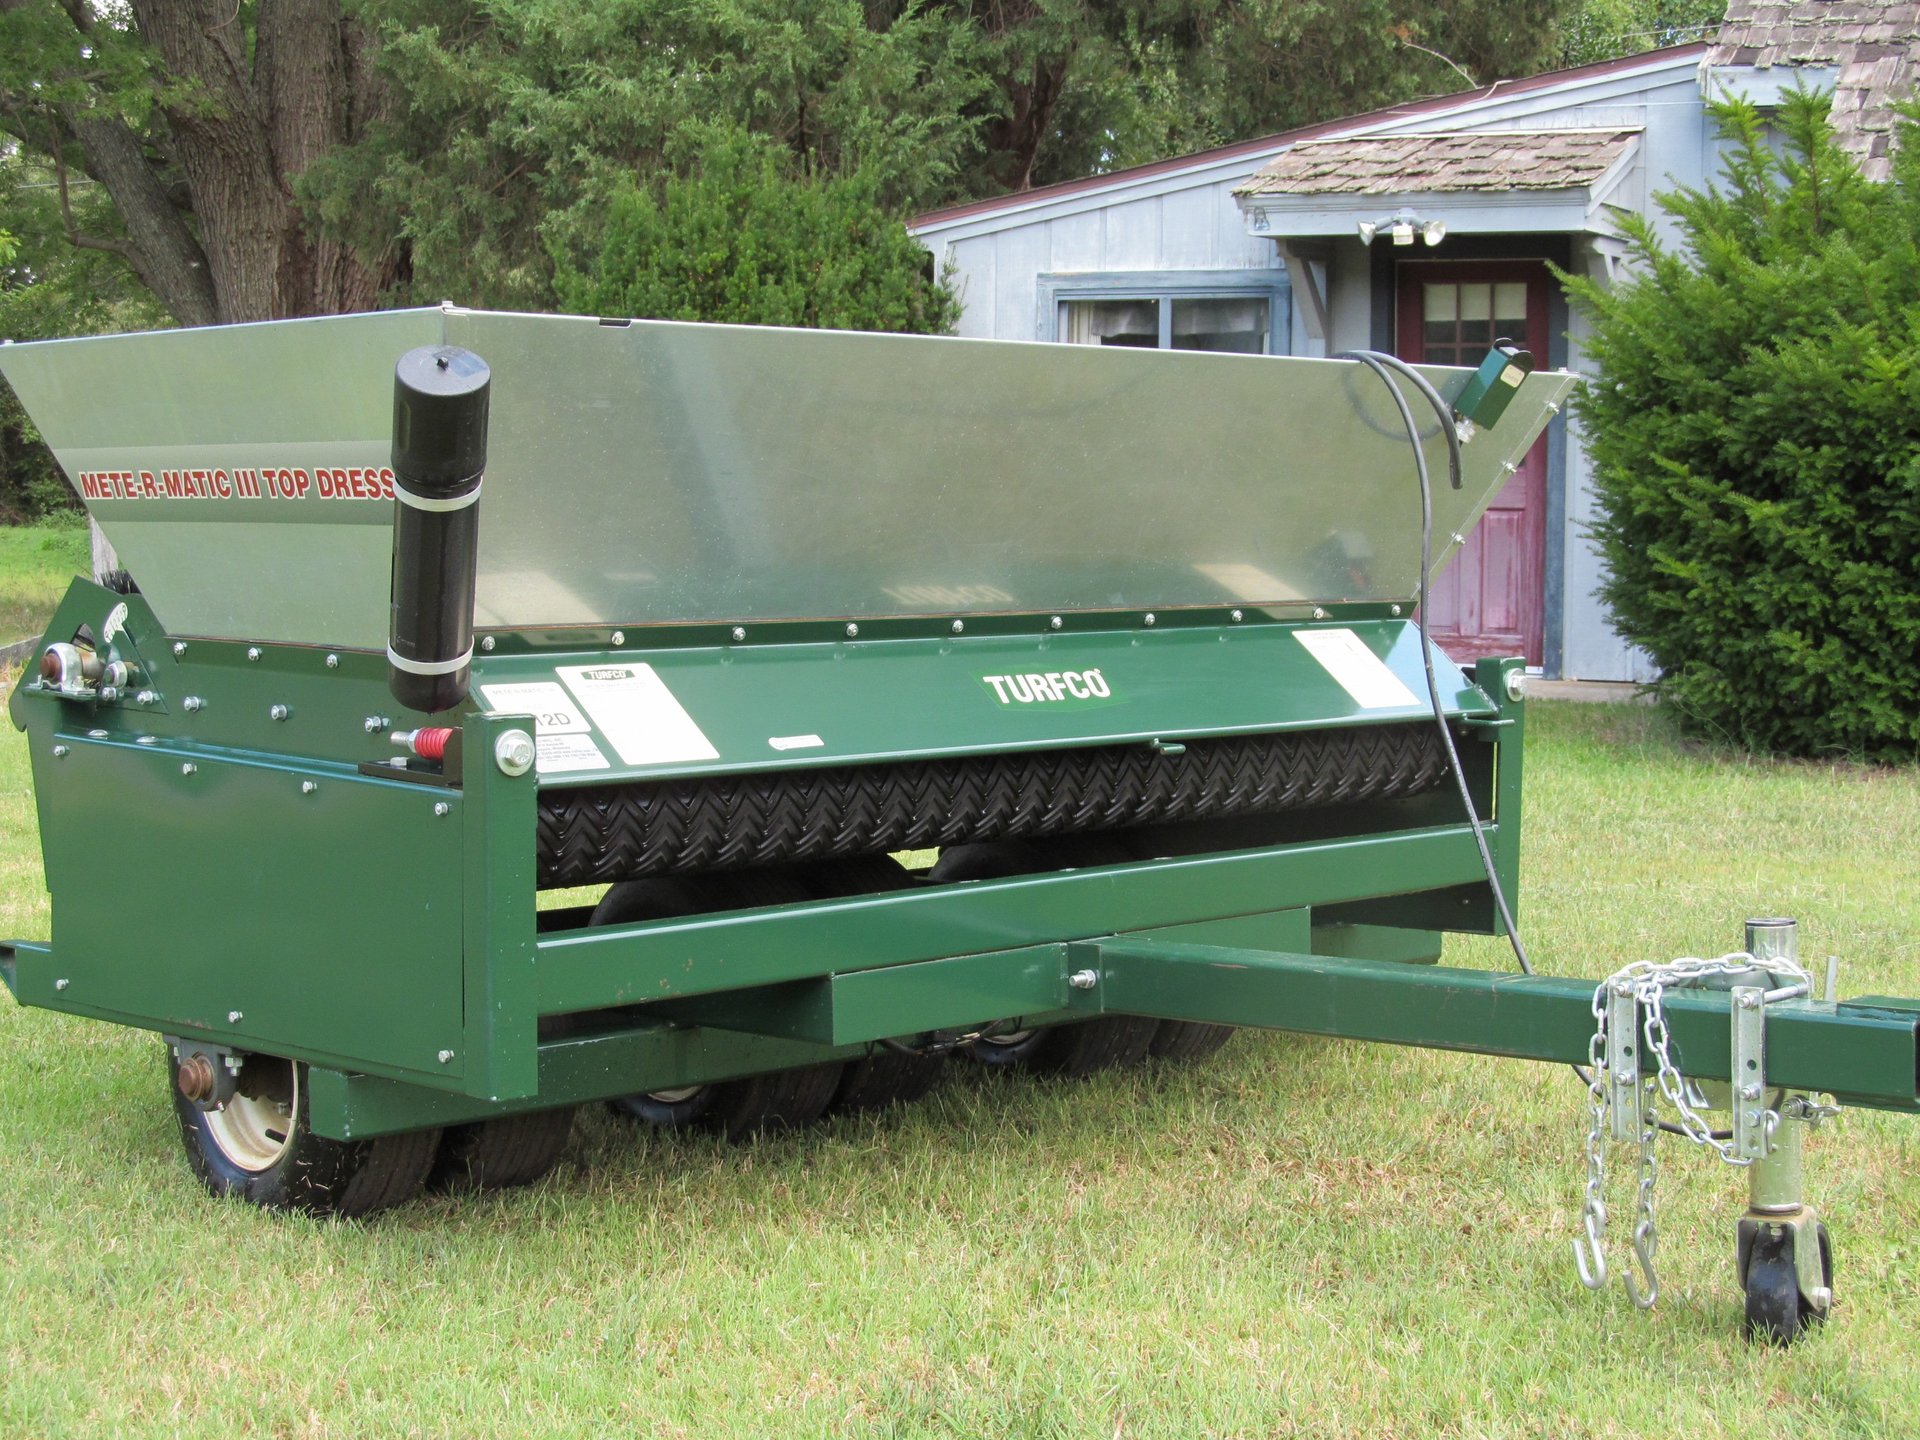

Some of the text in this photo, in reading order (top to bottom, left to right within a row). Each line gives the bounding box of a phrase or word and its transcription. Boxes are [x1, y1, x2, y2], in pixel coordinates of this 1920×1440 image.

[79, 468, 232, 500] METE-R-MATIC
[234, 468, 260, 499] III
[260, 467, 310, 499] TOP
[588, 670, 627, 680] TURFCO
[983, 669, 1111, 704] TURFCO
